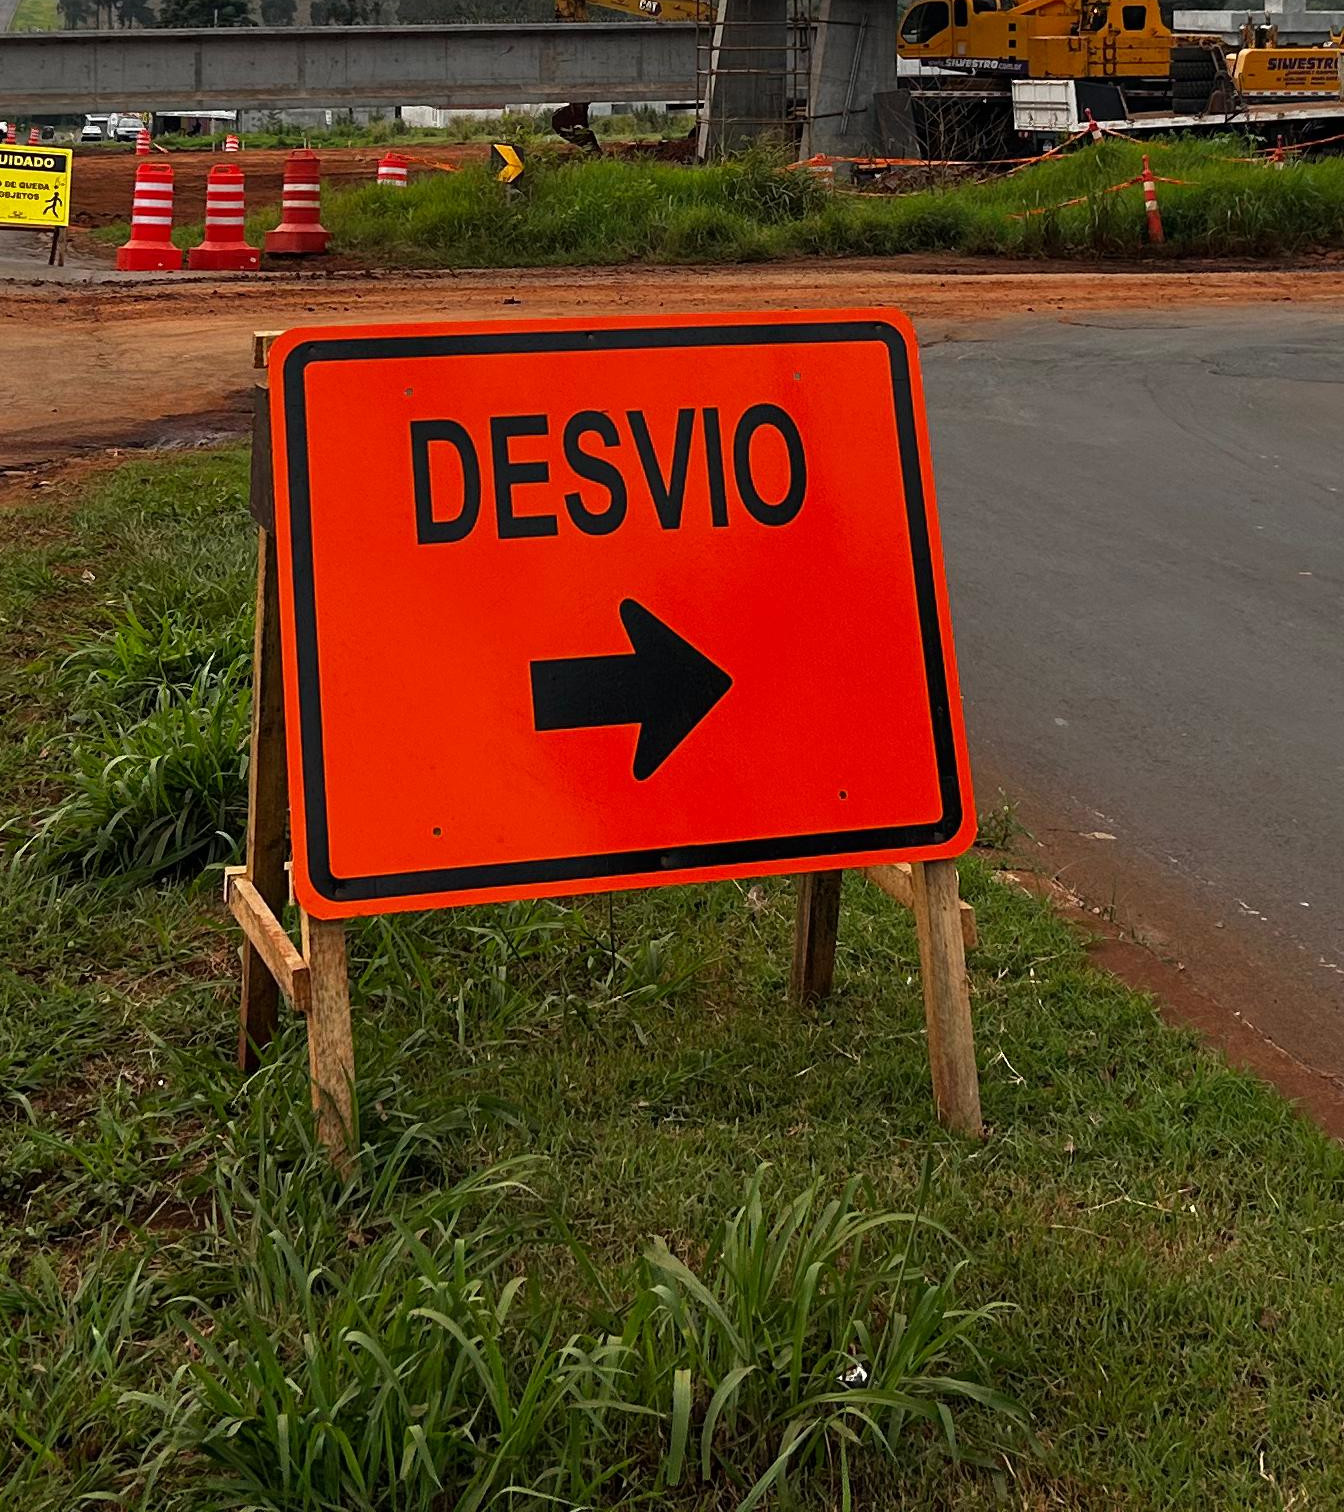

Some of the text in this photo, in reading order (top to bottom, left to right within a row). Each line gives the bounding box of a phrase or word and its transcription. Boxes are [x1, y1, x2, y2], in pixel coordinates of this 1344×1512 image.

[639, 0, 658, 13] CAT
[4, 180, 17, 189] DE
[18, 181, 50, 191] QUEDA
[408, 402, 810, 545] DESVIO
